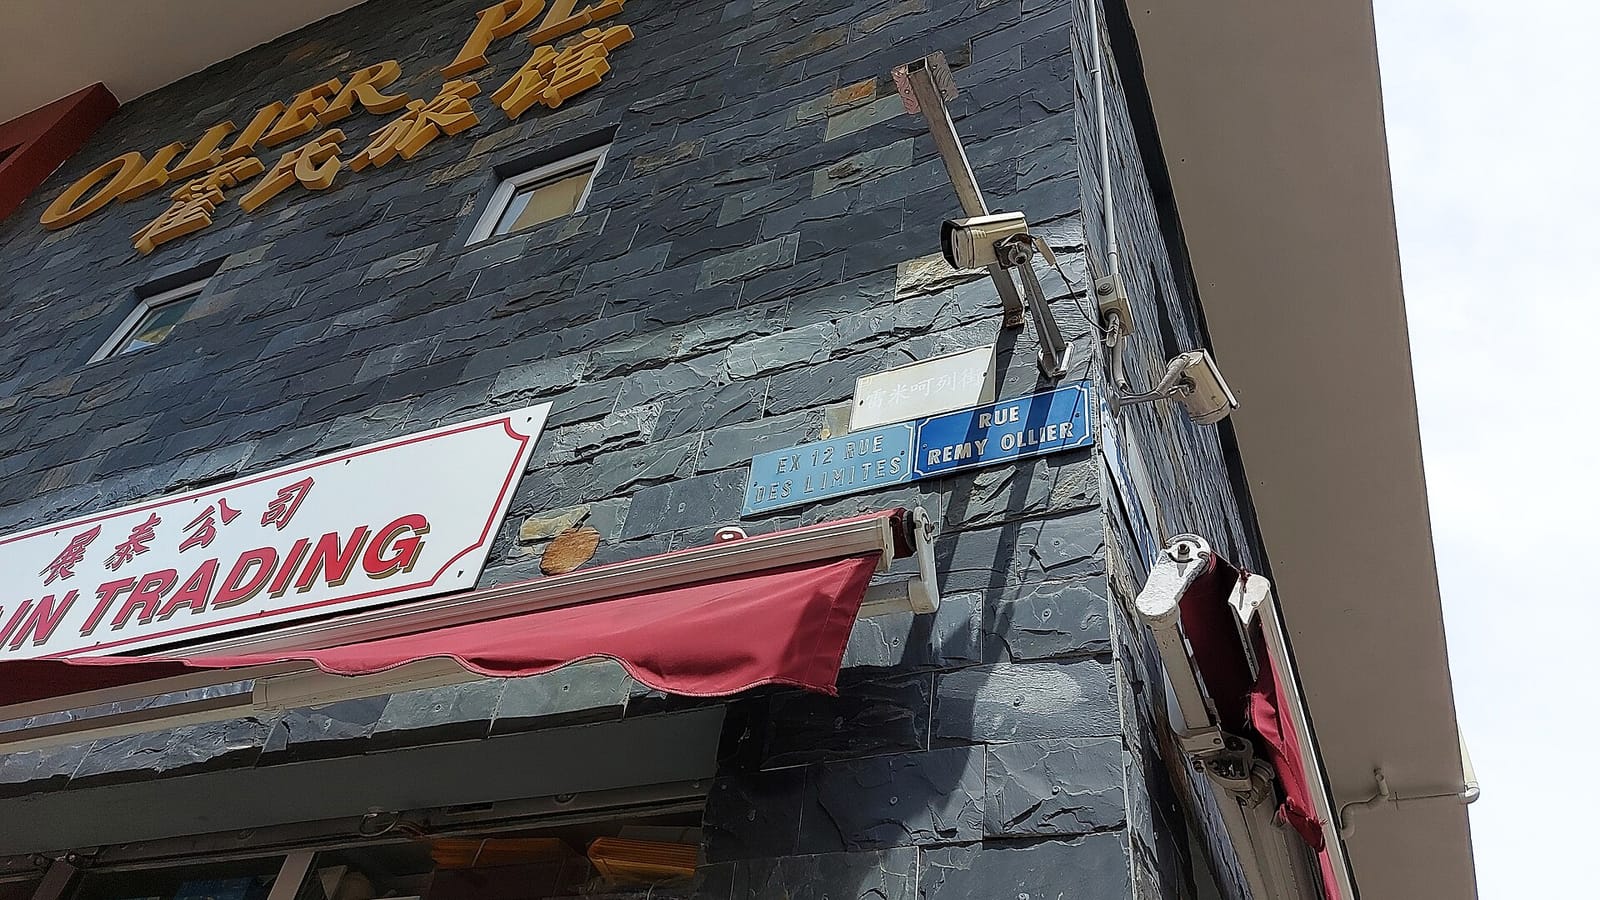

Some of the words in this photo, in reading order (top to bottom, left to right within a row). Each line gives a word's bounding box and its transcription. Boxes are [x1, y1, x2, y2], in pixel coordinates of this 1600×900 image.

[41, 59, 410, 231] OLLIER
[440, 0, 627, 80] PL
[131, 25, 634, 255] 霍氏旅館
[979, 405, 1020, 429] RUE
[775, 453, 801, 475] EX
[811, 446, 833, 467] 12
[844, 435, 884, 460] RUE
[928, 438, 989, 466] REMY
[1000, 422, 1075, 451] OLLIER
[753, 477, 793, 504] DES
[804, 455, 902, 495] LIMITES
[0, 589, 80, 651] IN
[80, 513, 430, 637] TRADING
